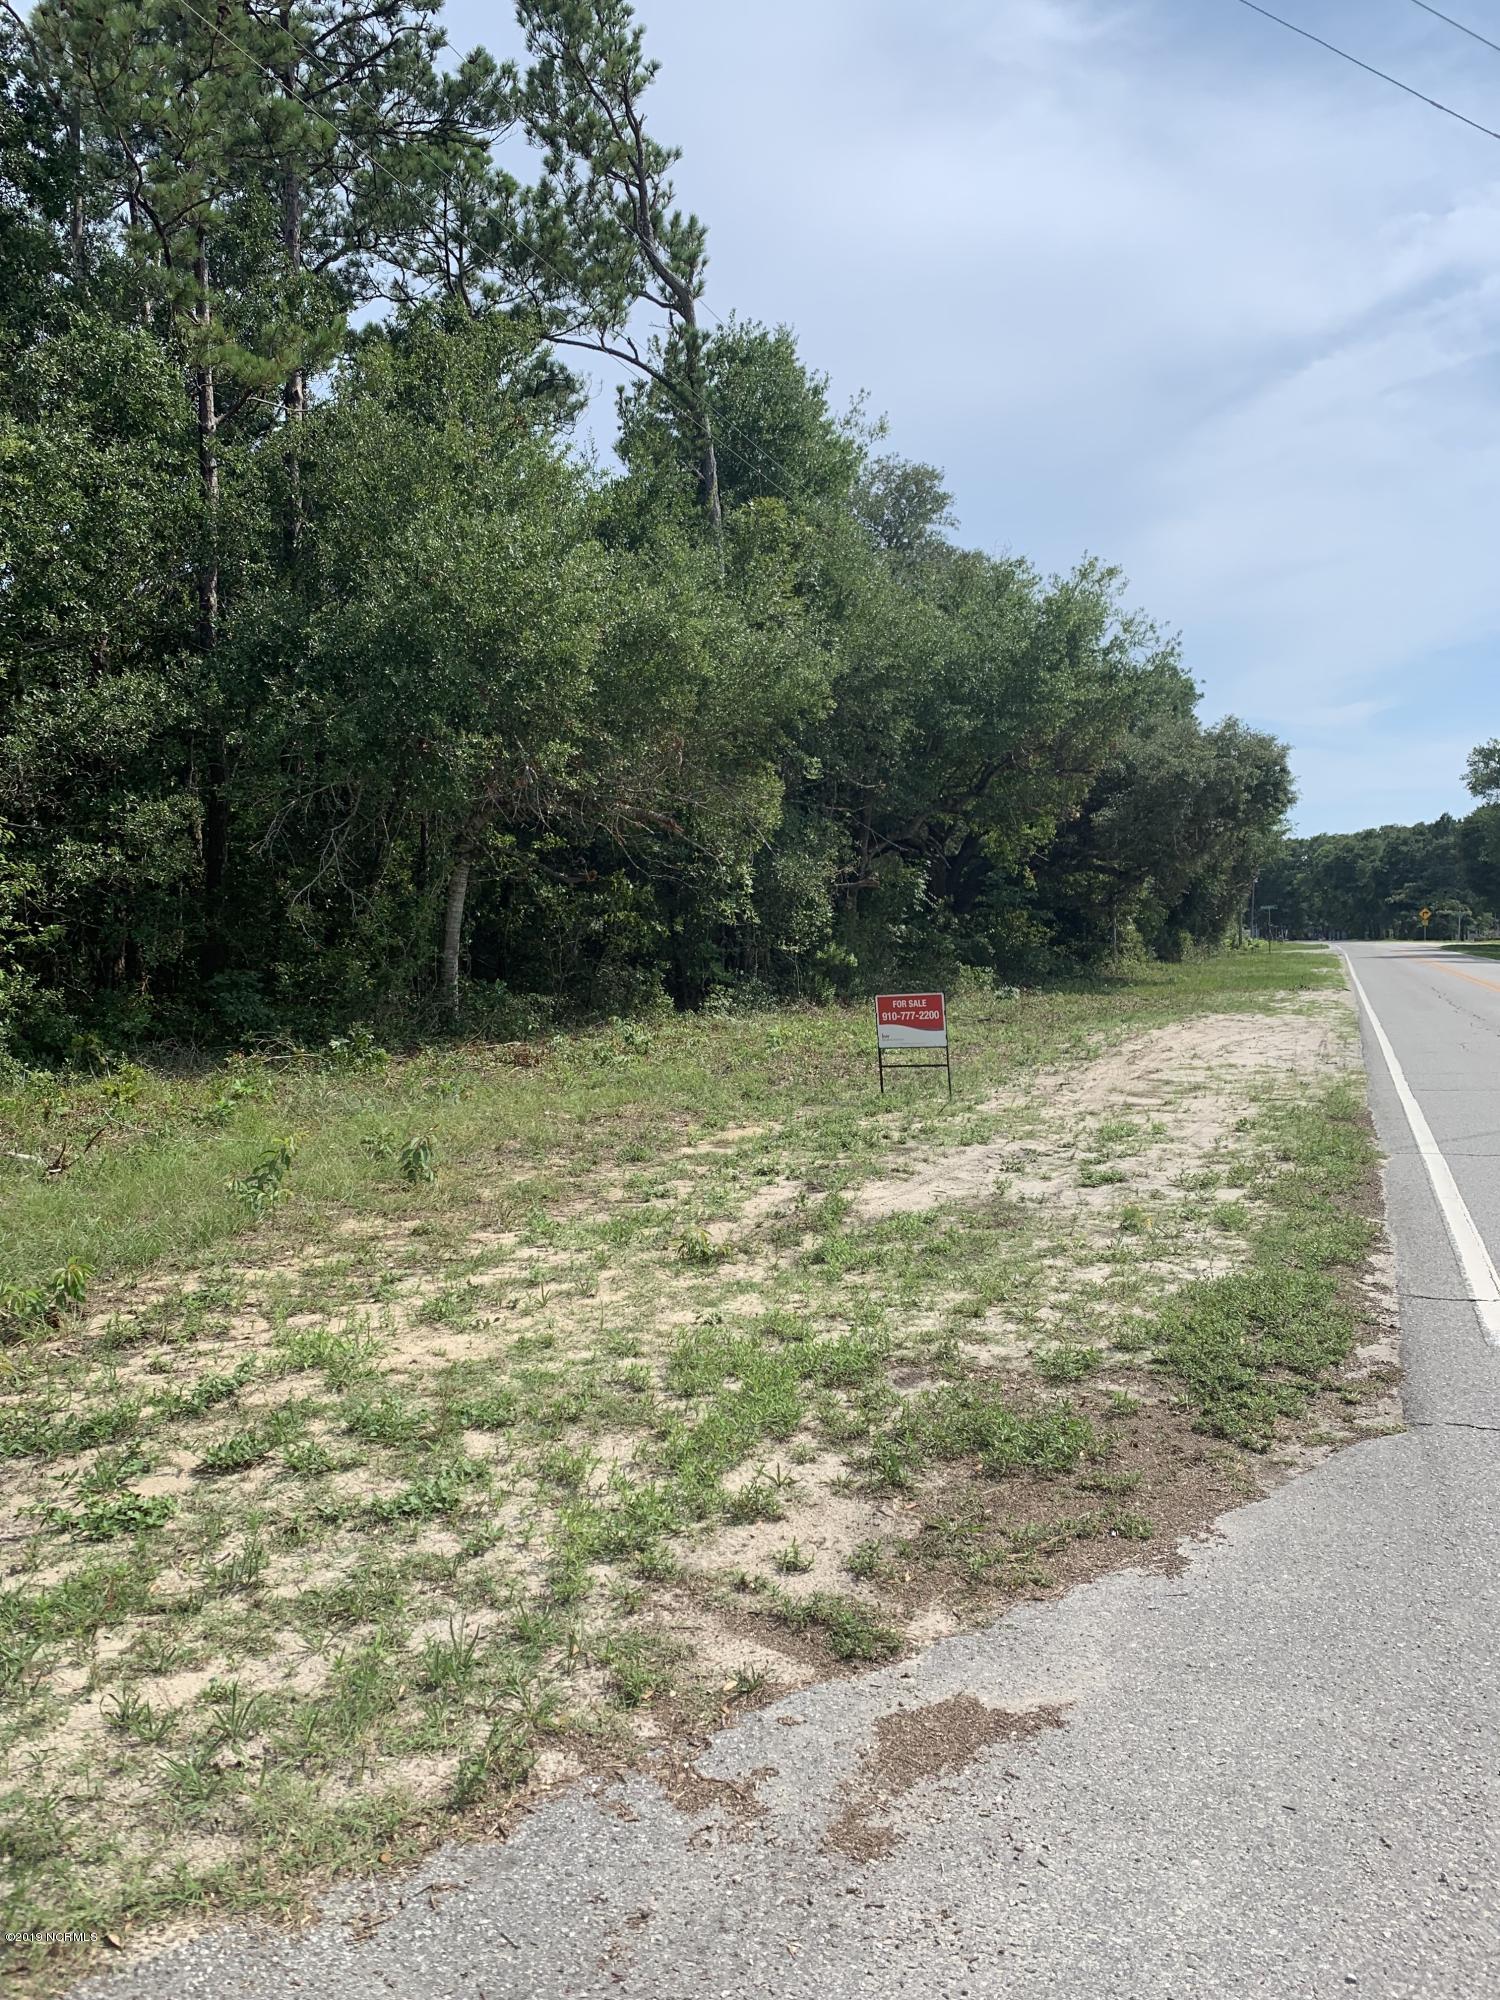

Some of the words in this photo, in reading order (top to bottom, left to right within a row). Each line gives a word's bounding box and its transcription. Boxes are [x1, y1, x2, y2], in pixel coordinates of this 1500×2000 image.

[892, 1000, 907, 1008] FOR
[908, 999, 927, 1008] SALE
[882, 1010, 940, 1021] 910-777-2200
